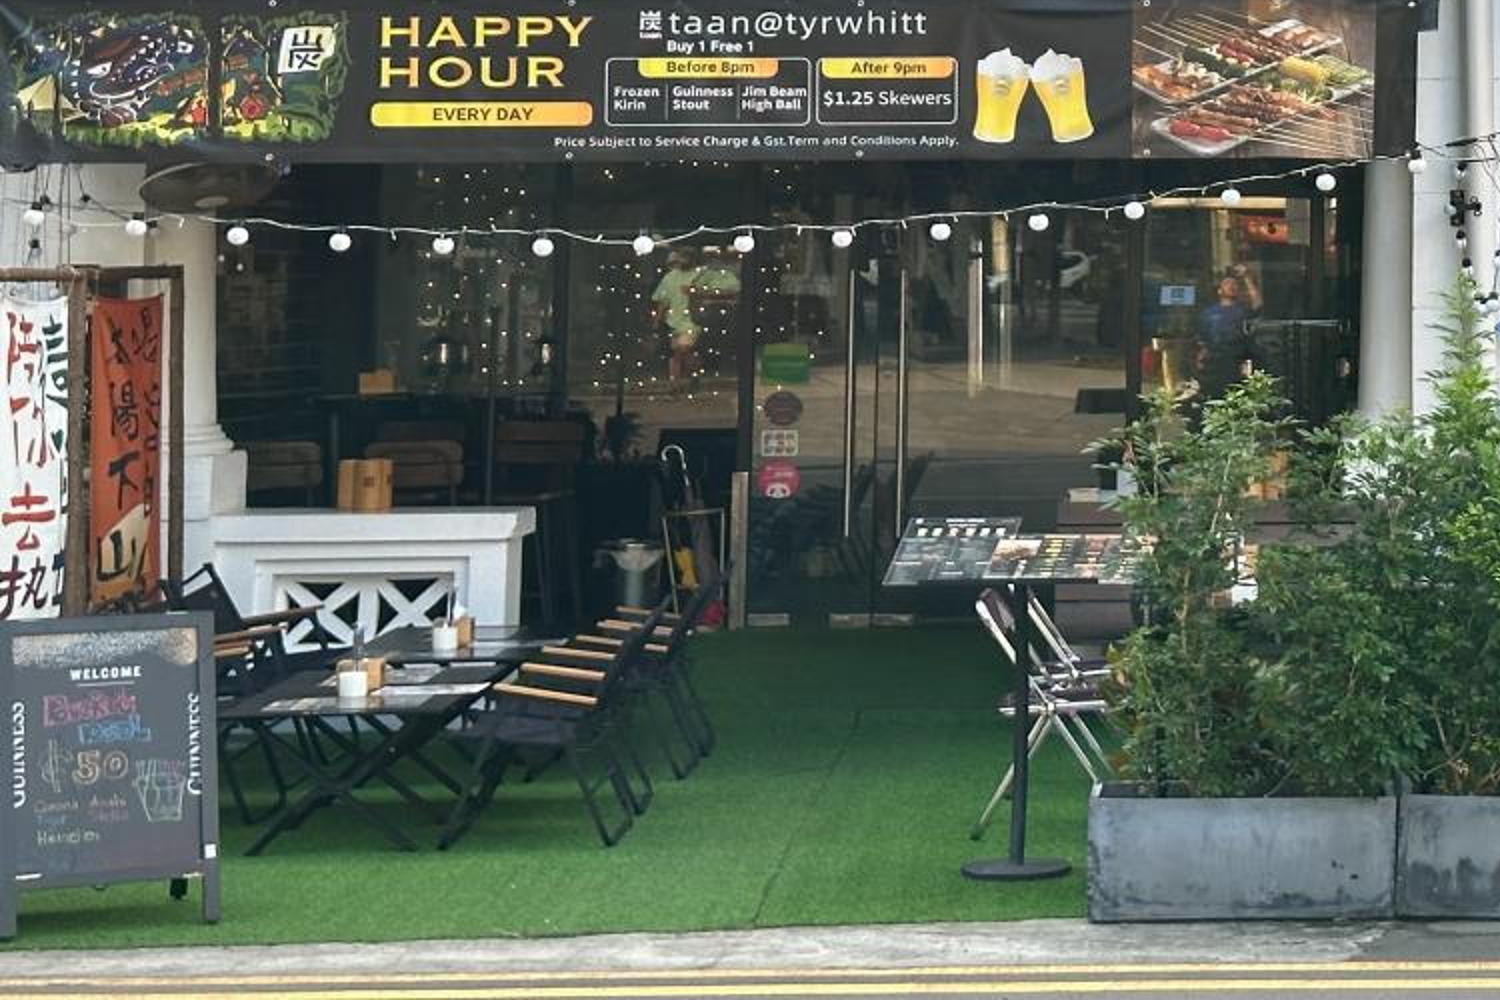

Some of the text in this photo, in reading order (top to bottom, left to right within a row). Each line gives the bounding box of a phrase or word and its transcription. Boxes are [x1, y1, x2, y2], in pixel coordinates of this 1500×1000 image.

[380, 15, 593, 48] HAPPY
[668, 10, 927, 40] taan@tyrwhitt
[288, 33, 322, 69] 炭
[667, 40, 754, 55] Buy 1 Free 1
[380, 55, 565, 88] HOUR
[667, 61, 755, 76] Before 8pm
[852, 61, 926, 77] After 9pm
[614, 86, 660, 97] Frozen
[672, 86, 733, 97] Guinness
[742, 86, 807, 97] Jim Beam
[823, 90, 952, 107] $1.25 Skewers
[614, 99, 646, 110] Kirin
[672, 99, 710, 110] Stout
[742, 98, 801, 112] High Ball
[433, 107, 534, 121] EVERY DAY
[554, 136, 586, 147] Price
[590, 136, 636, 149] Subject
[639, 137, 652, 147] to
[655, 135, 700, 147] Service
[703, 135, 749, 149] Charge
[823, 136, 847, 146] and
[851, 135, 917, 147] Conditions
[921, 135, 959, 150] Apply.
[69, 665, 142, 681] WELCOME
